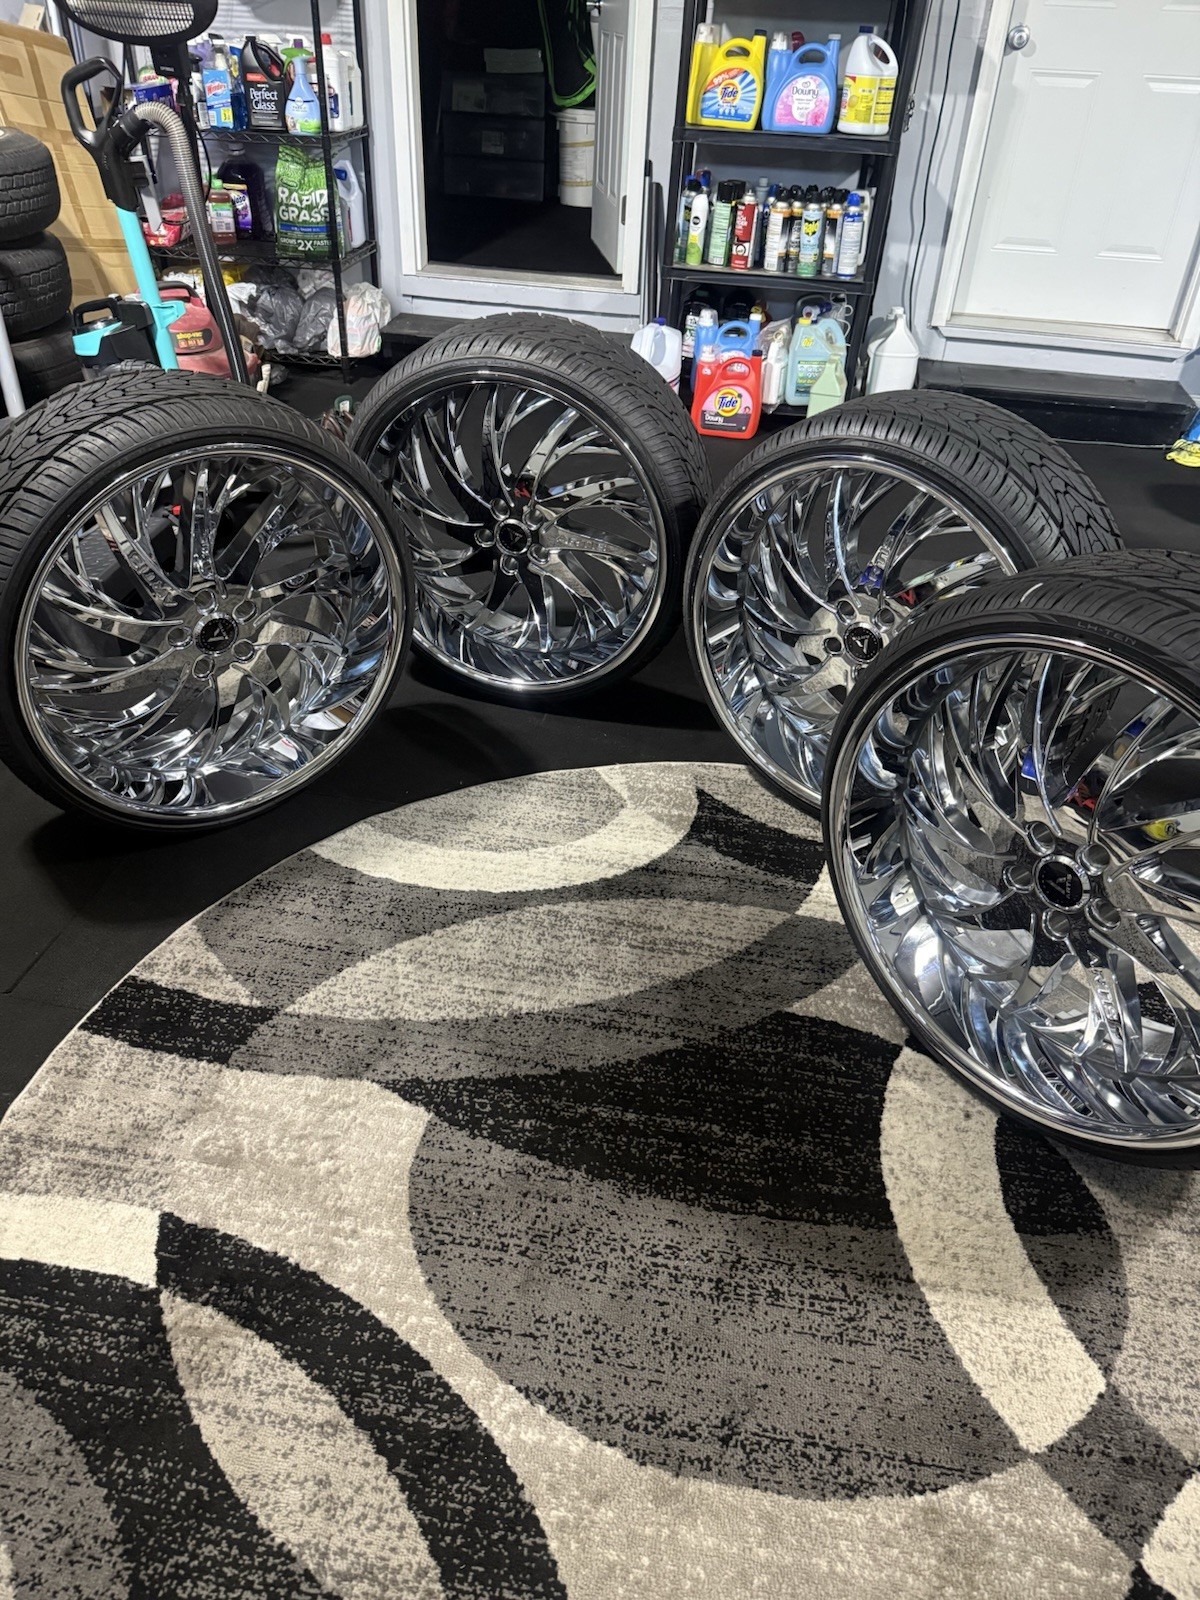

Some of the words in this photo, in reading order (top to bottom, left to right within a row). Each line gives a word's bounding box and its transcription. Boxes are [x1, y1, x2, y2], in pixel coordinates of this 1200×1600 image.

[249, 87, 279, 101] Perfect
[720, 86, 738, 100] Tide
[791, 86, 819, 99] Downy
[252, 99, 277, 112] Glass
[277, 186, 329, 210] RAPID
[279, 205, 330, 222] GRASS
[297, 240, 314, 251] 2X
[718, 395, 738, 409] Tide
[704, 413, 725, 424] Downy
